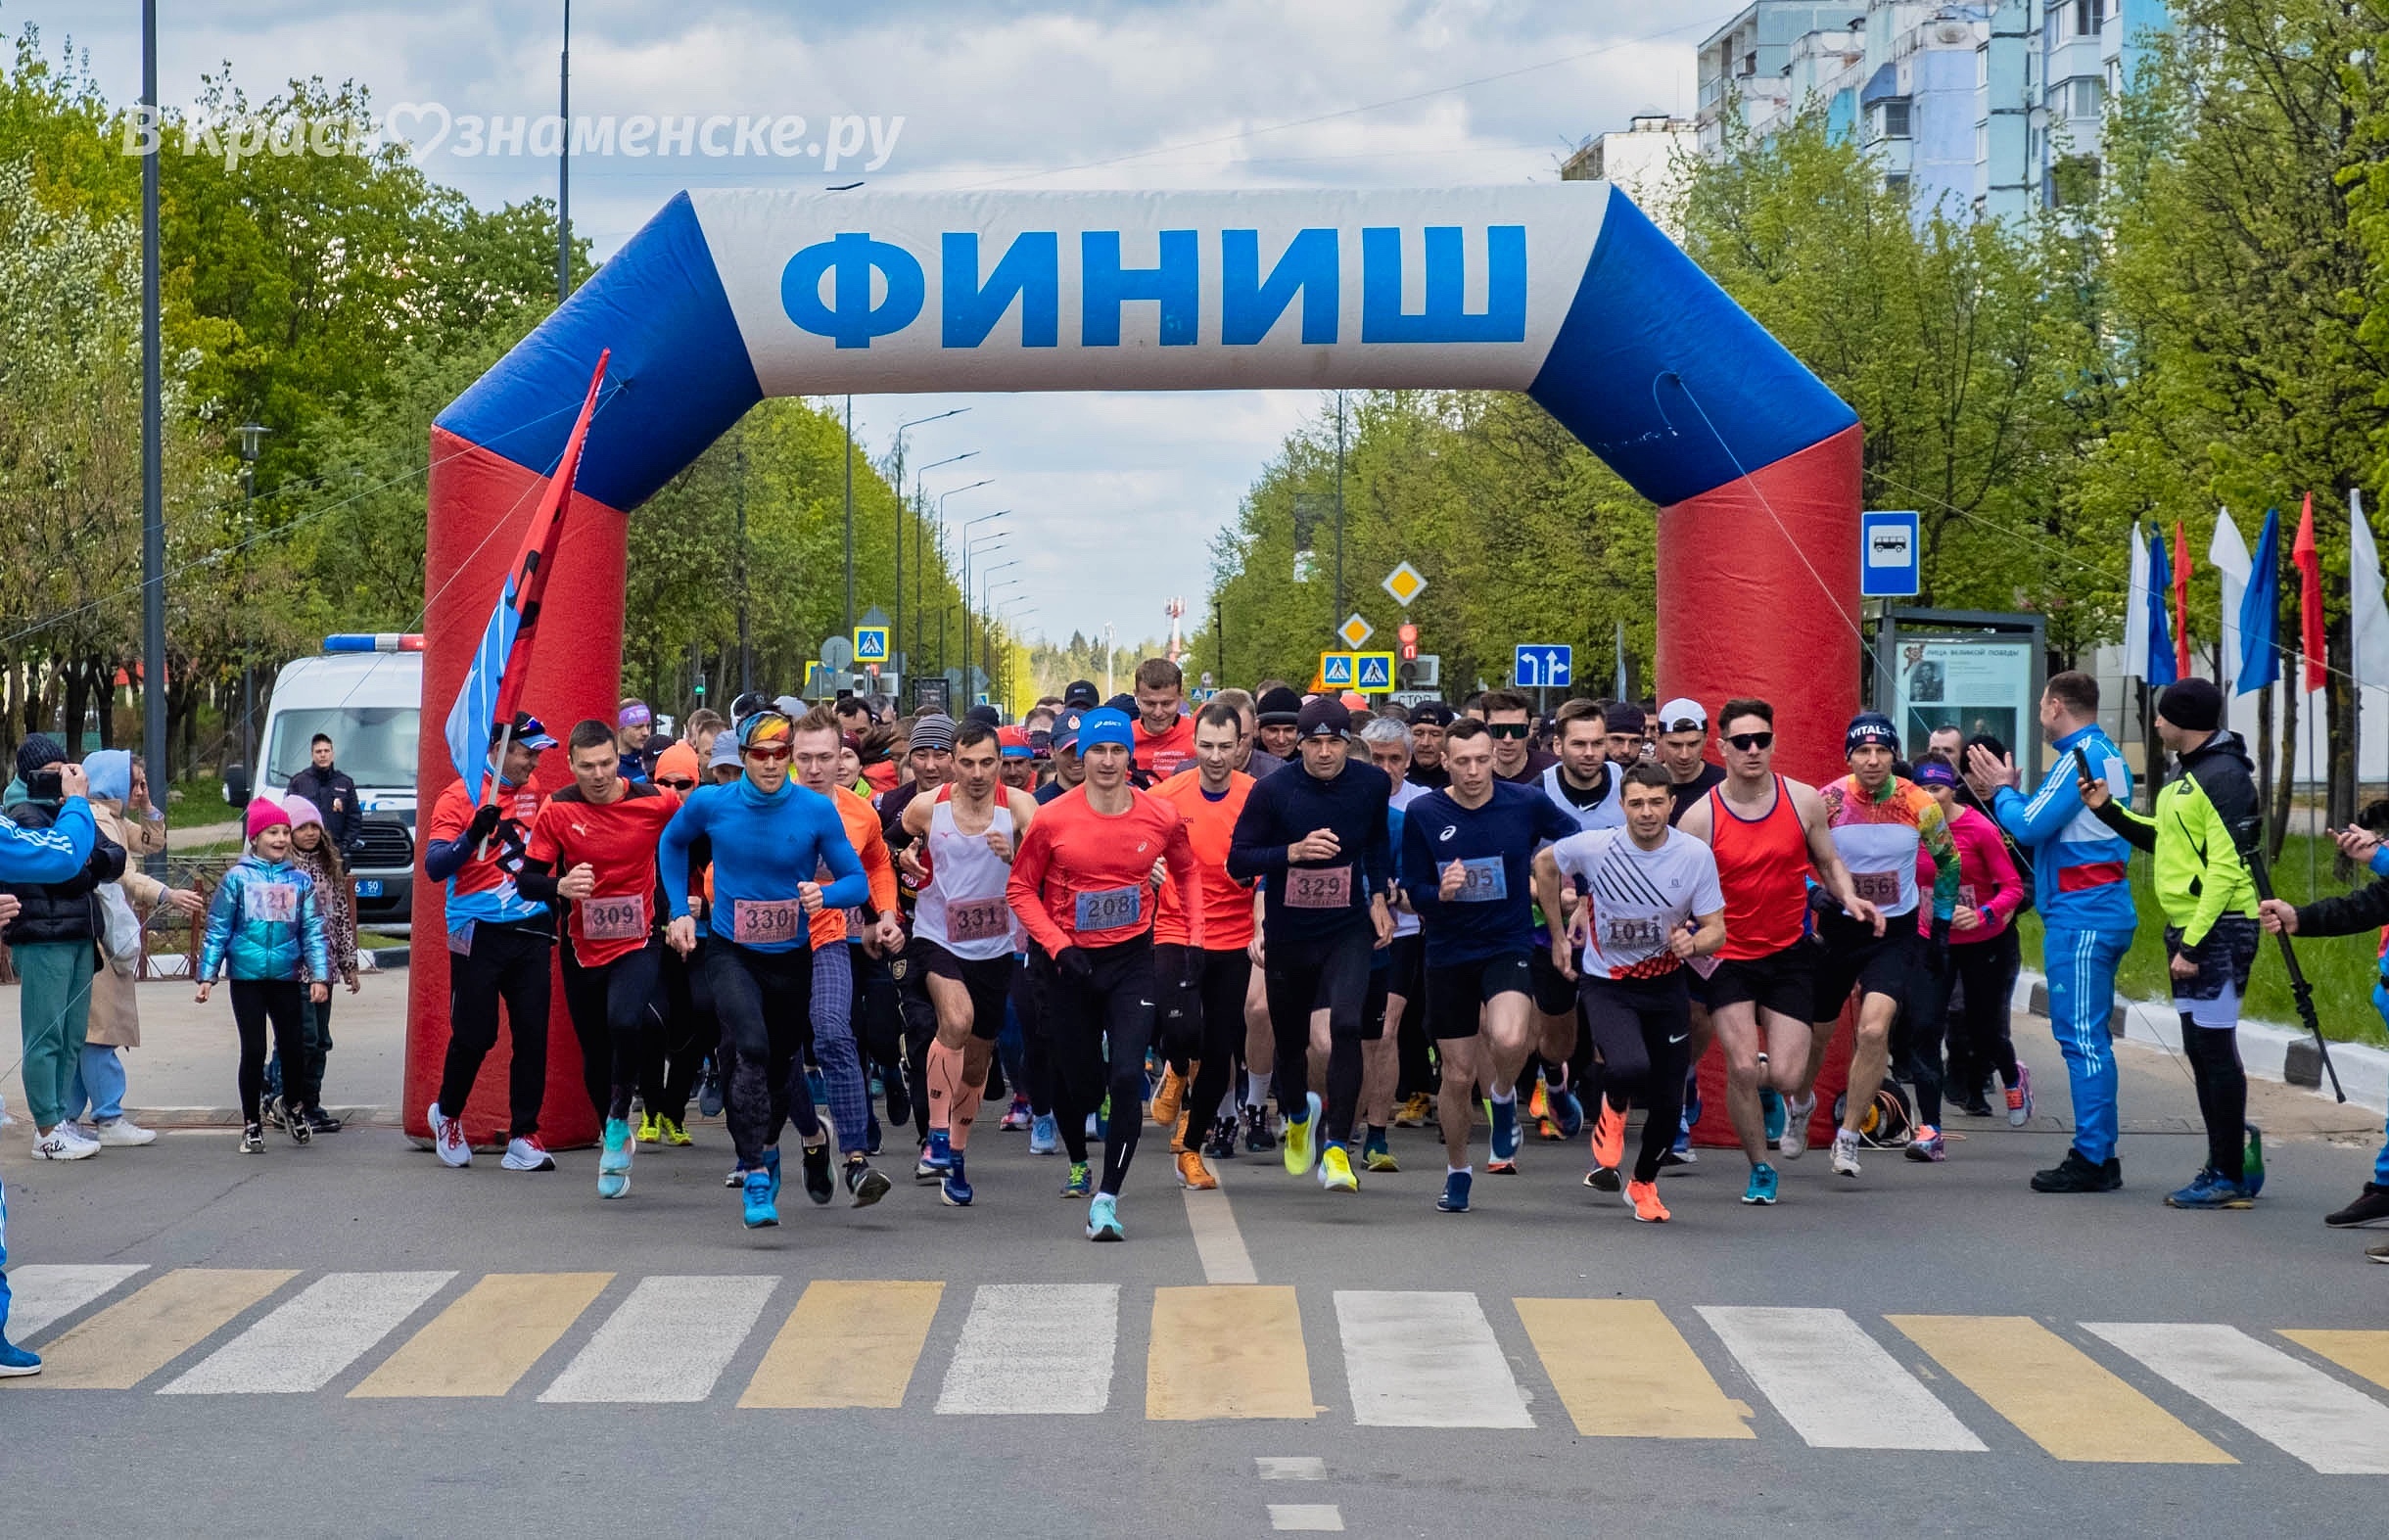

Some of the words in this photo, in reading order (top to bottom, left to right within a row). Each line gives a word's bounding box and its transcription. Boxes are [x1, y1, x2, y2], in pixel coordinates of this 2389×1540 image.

[781, 225, 1526, 349] ФИНИШ
[1297, 877, 1339, 896] 329
[1467, 867, 1494, 888] 05
[592, 905, 634, 926] 309
[1088, 895, 1130, 918] 208
[745, 909, 789, 929] 330
[957, 907, 997, 929] 331
